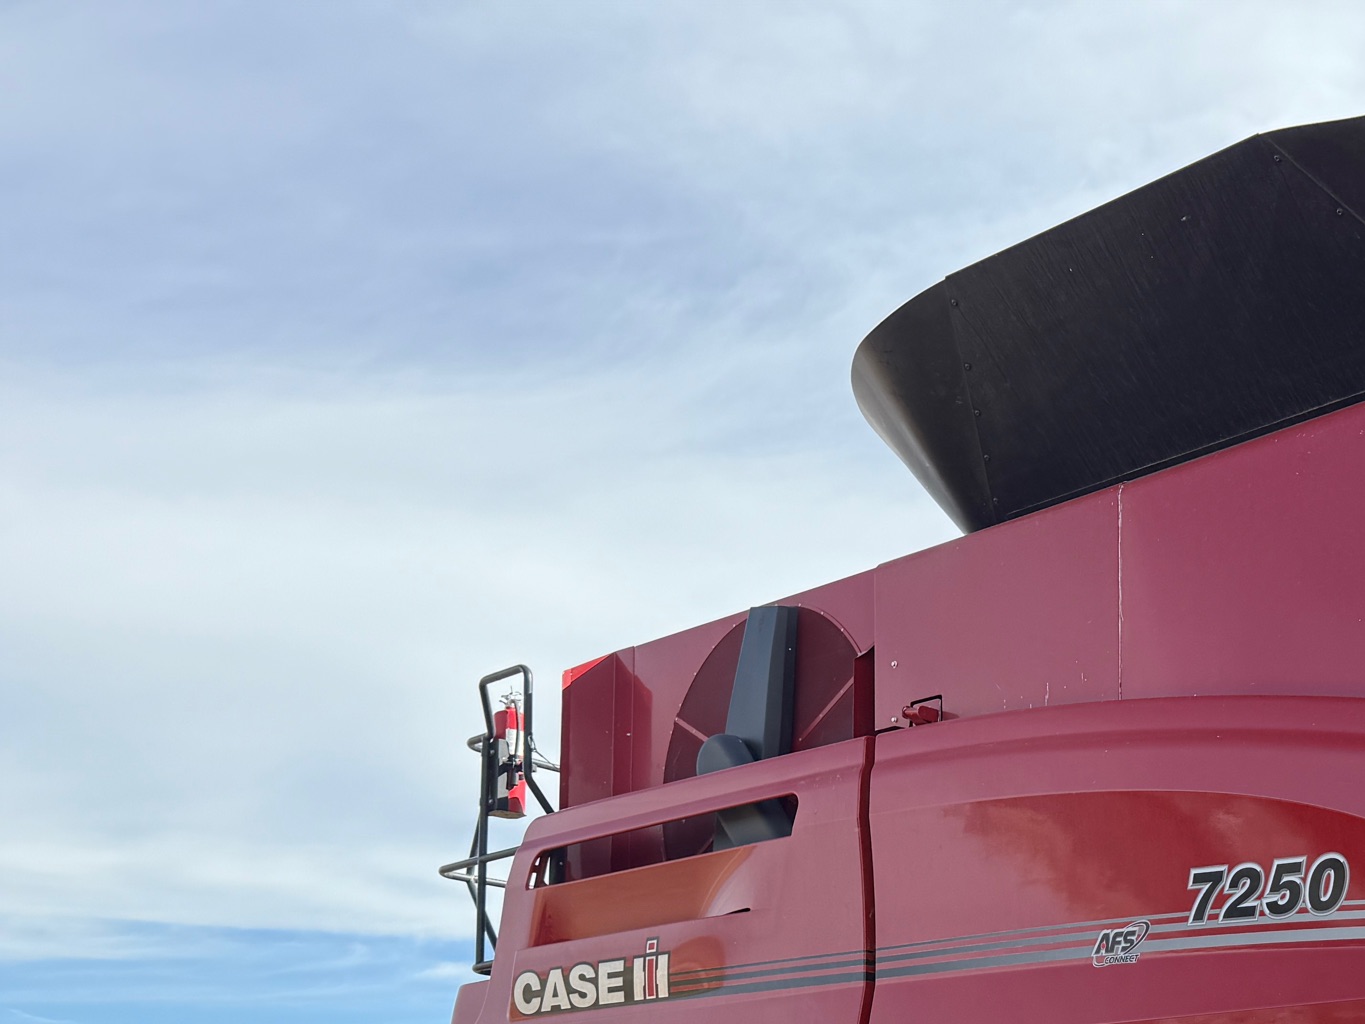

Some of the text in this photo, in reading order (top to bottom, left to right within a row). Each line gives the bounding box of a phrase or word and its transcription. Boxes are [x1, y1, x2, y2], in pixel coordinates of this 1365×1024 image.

[1187, 852, 1350, 926] 7250
[1093, 929, 1138, 955] AFS
[1105, 954, 1140, 965] CONNECT
[513, 958, 626, 1016] CASE
